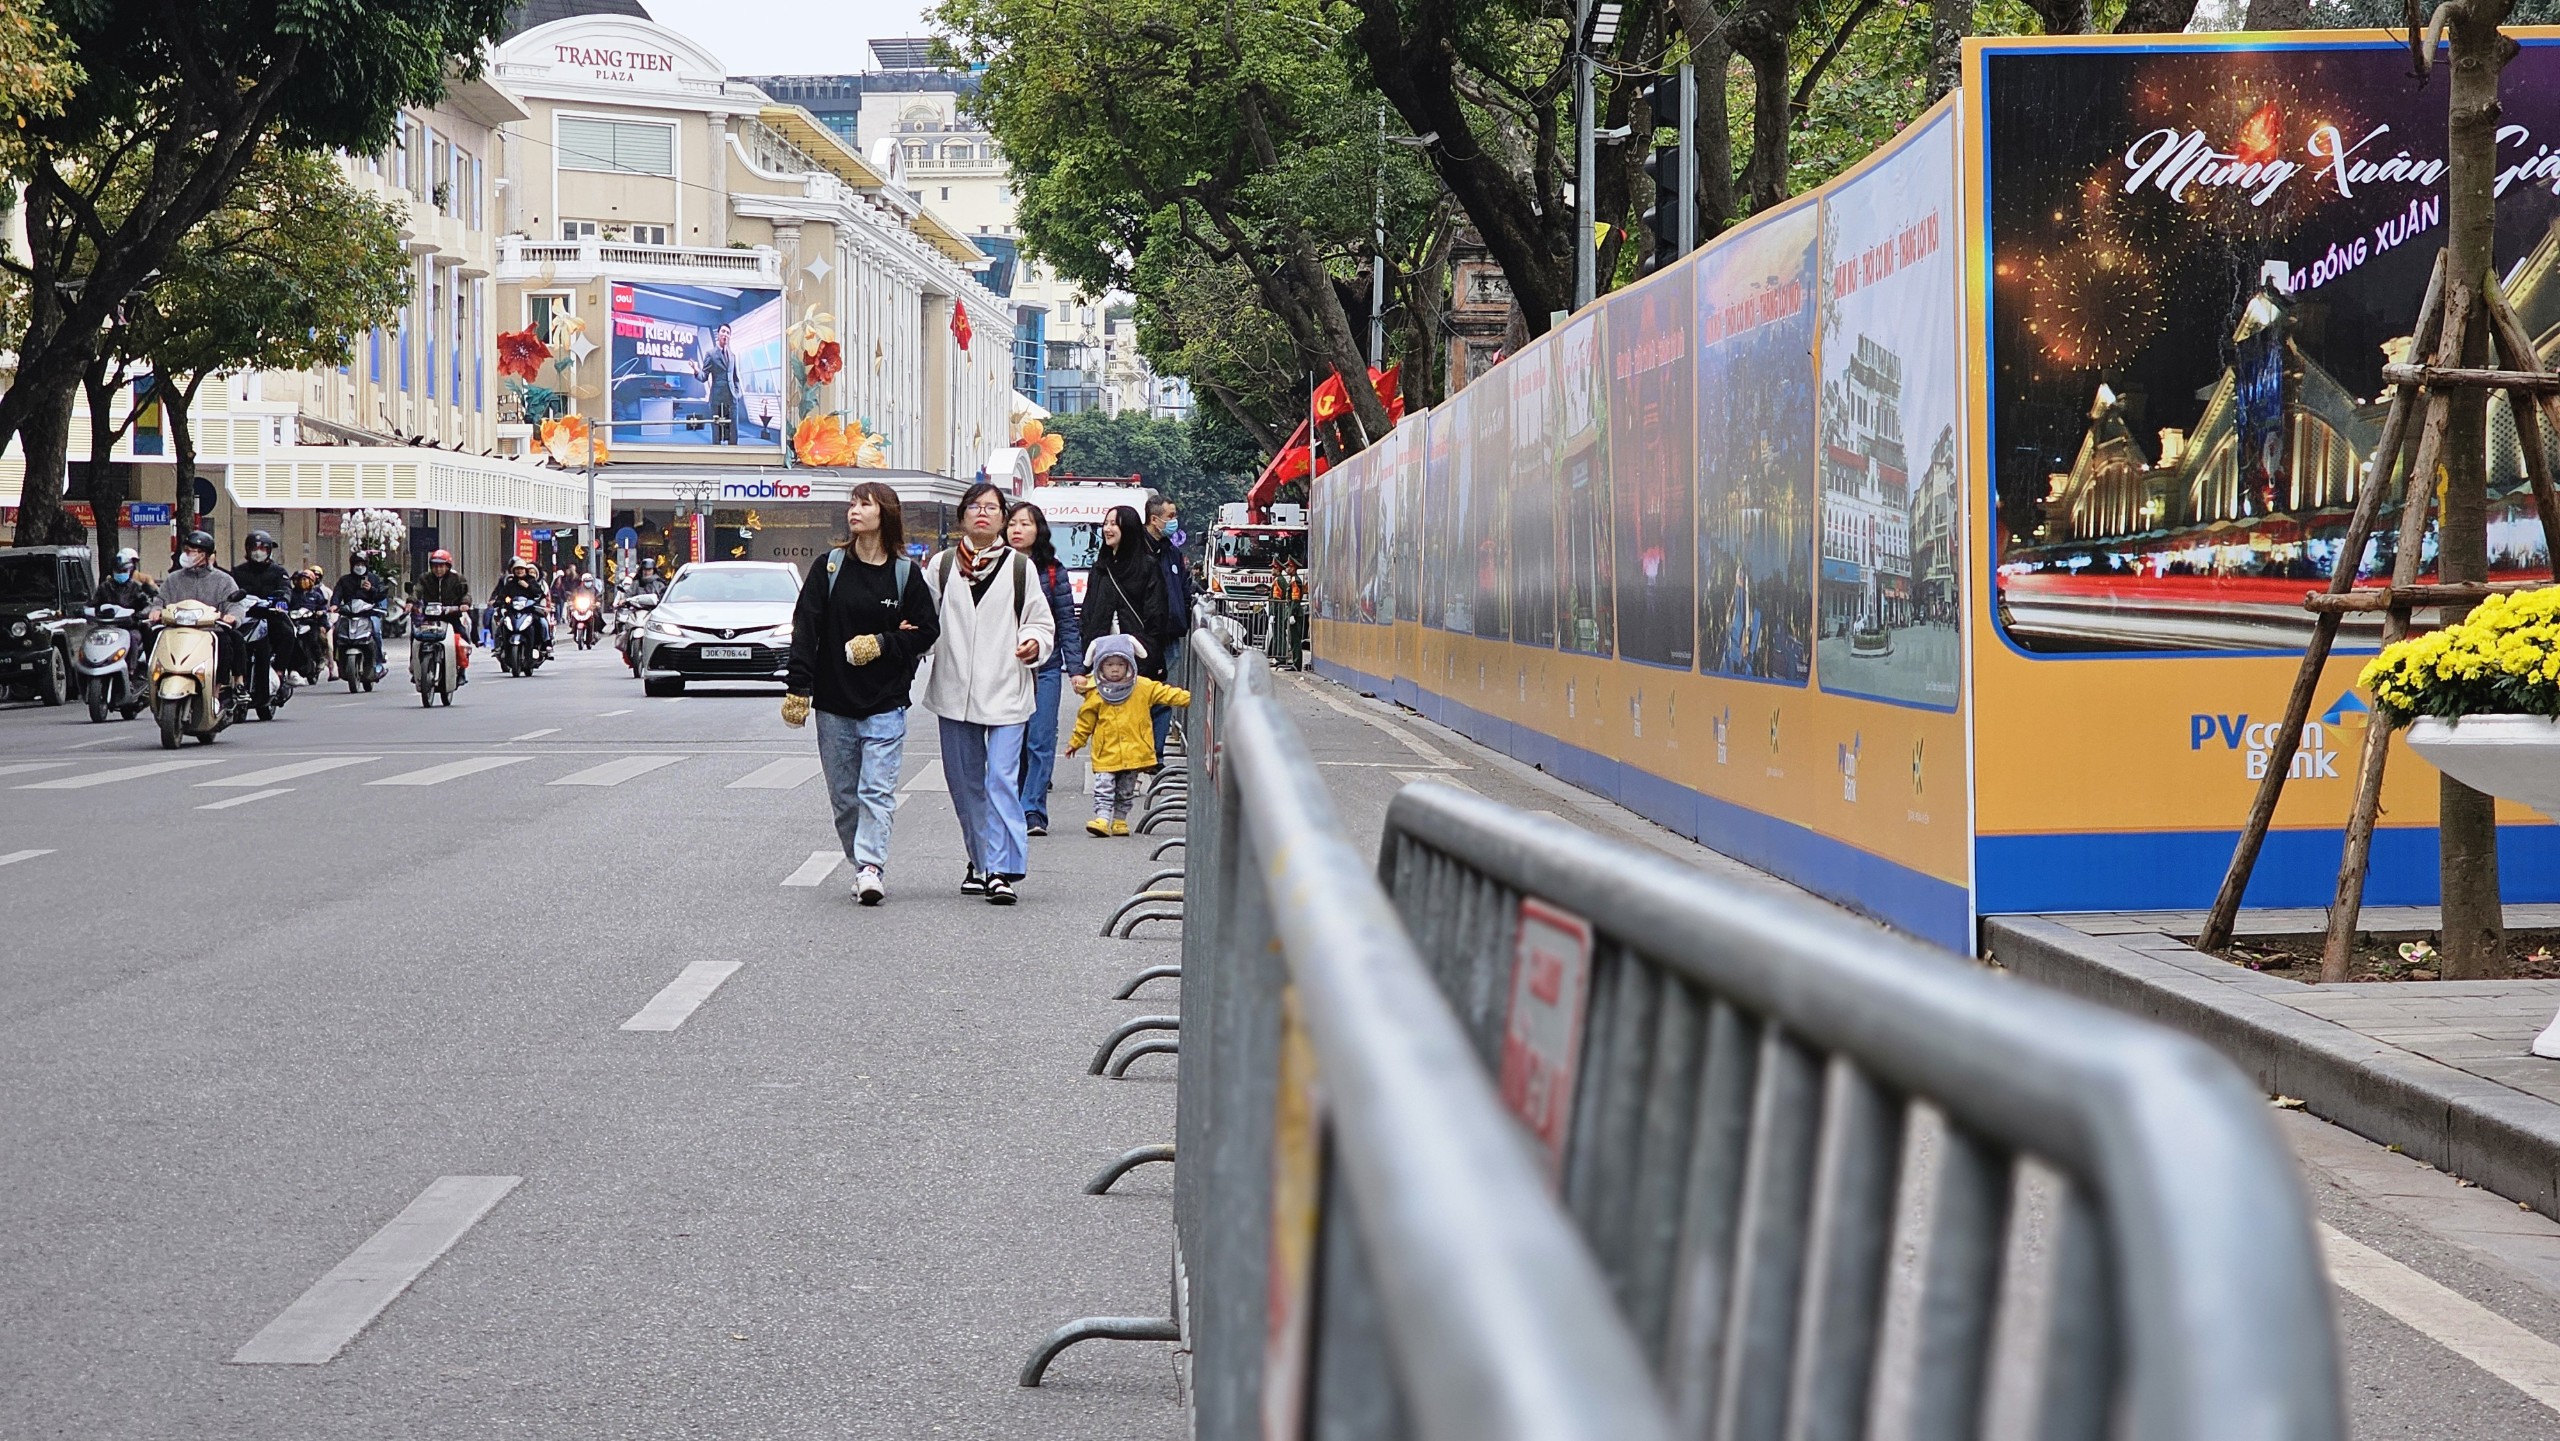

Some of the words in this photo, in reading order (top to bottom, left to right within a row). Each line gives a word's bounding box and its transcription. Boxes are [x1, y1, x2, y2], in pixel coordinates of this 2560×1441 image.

[555, 45, 622, 67] TRANG
[626, 52, 673, 72] TIEN
[596, 70, 634, 81] PLAZA
[2124, 128, 2305, 206] Mừng
[2308, 124, 2449, 198] Xuân
[2375, 195, 2439, 256] XUÂN
[616, 322, 643, 338] DELI
[662, 340, 684, 359] SẮC
[724, 479, 811, 498] mobifone
[773, 547, 814, 556] GUCCI
[2246, 750, 2339, 780] Bnk
